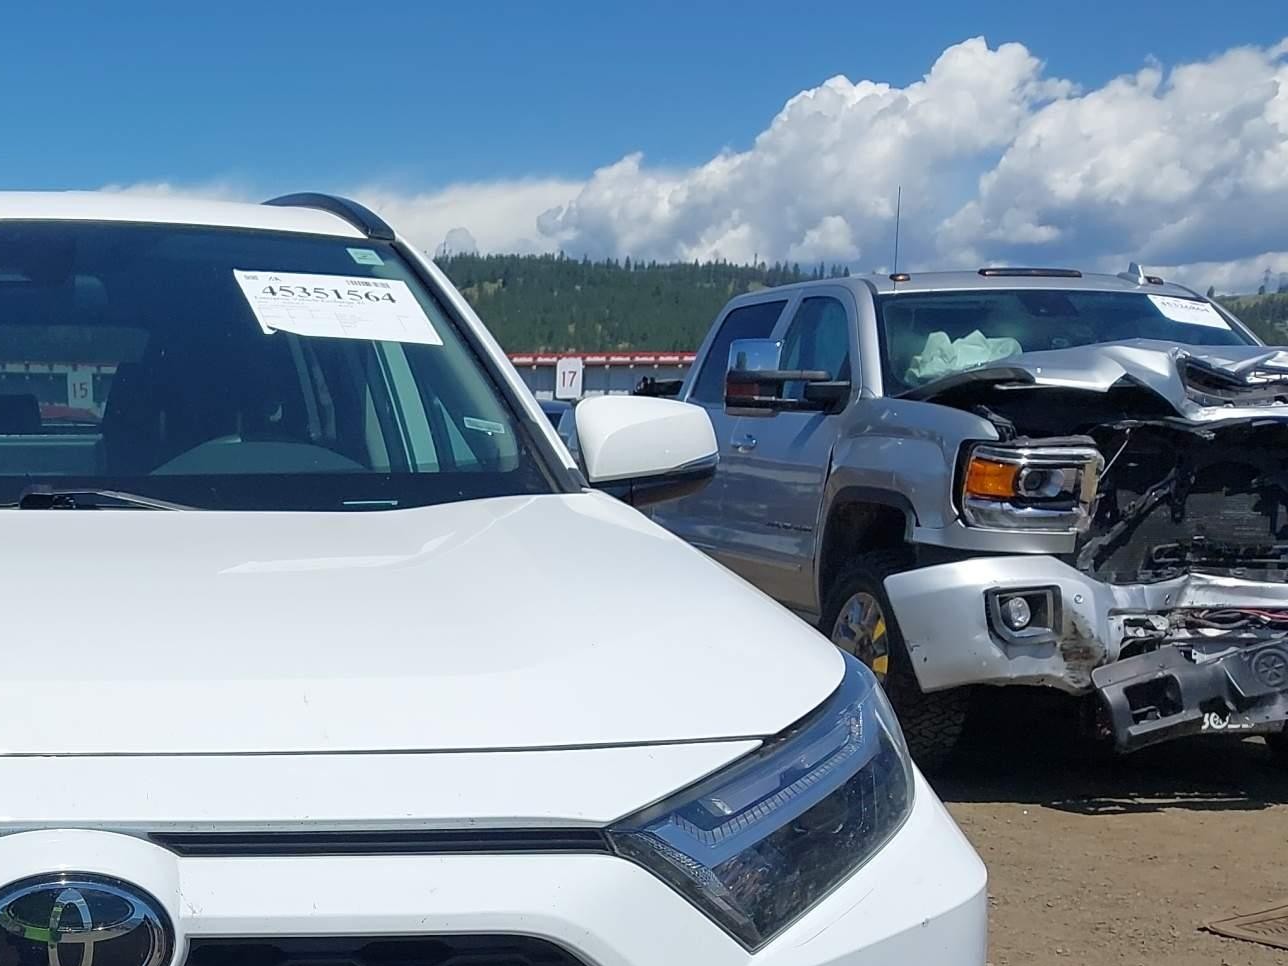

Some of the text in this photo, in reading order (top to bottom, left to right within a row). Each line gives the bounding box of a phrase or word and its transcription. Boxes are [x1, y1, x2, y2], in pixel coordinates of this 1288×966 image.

[261, 285, 397, 304] 45351564
[560, 370, 578, 388] 17
[72, 382, 89, 399] 15
